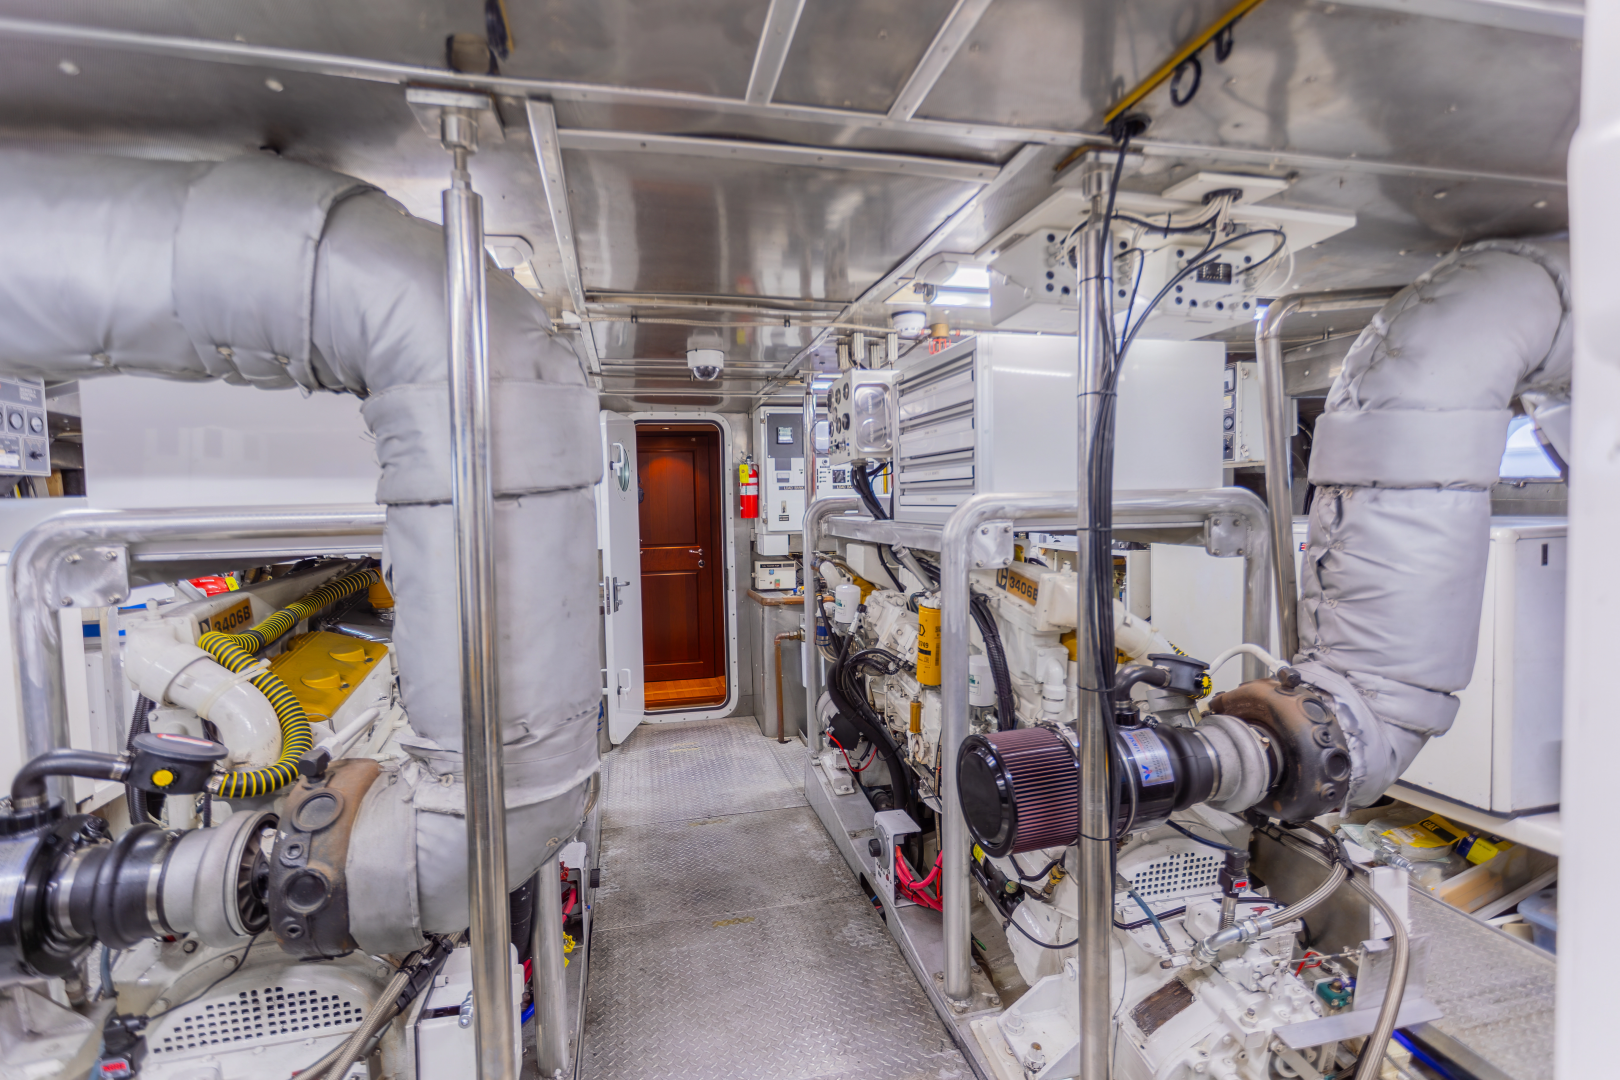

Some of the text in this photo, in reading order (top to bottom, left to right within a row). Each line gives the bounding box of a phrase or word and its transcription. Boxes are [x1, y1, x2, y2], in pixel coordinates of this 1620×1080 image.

[1009, 576, 1039, 602] 3406B
[214, 605, 251, 634] 3406B
[1422, 821, 1440, 832] CAT
